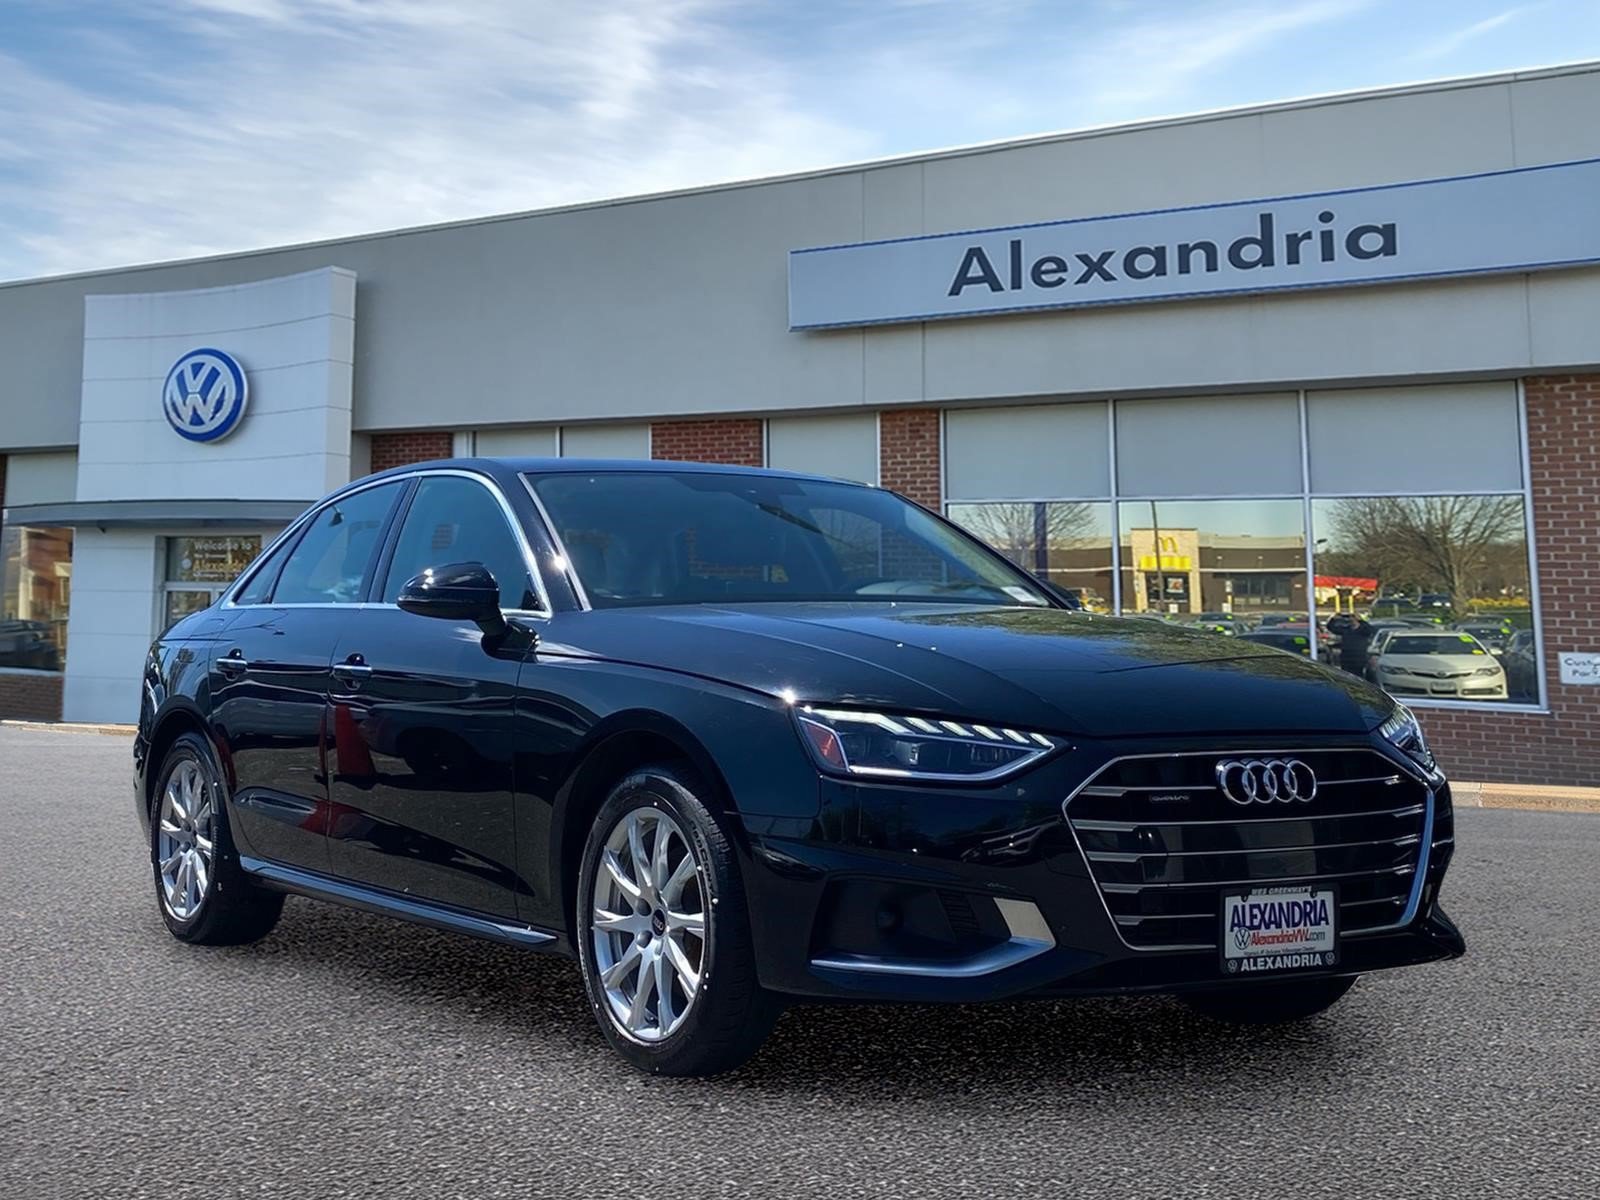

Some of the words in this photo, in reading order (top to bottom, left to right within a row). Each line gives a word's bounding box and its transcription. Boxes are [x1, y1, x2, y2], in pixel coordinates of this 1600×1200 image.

[948, 210, 1397, 296] Alexandria
[1229, 899, 1330, 932] ALEXANDRIA
[1240, 953, 1322, 972] ALEXANDRIA
